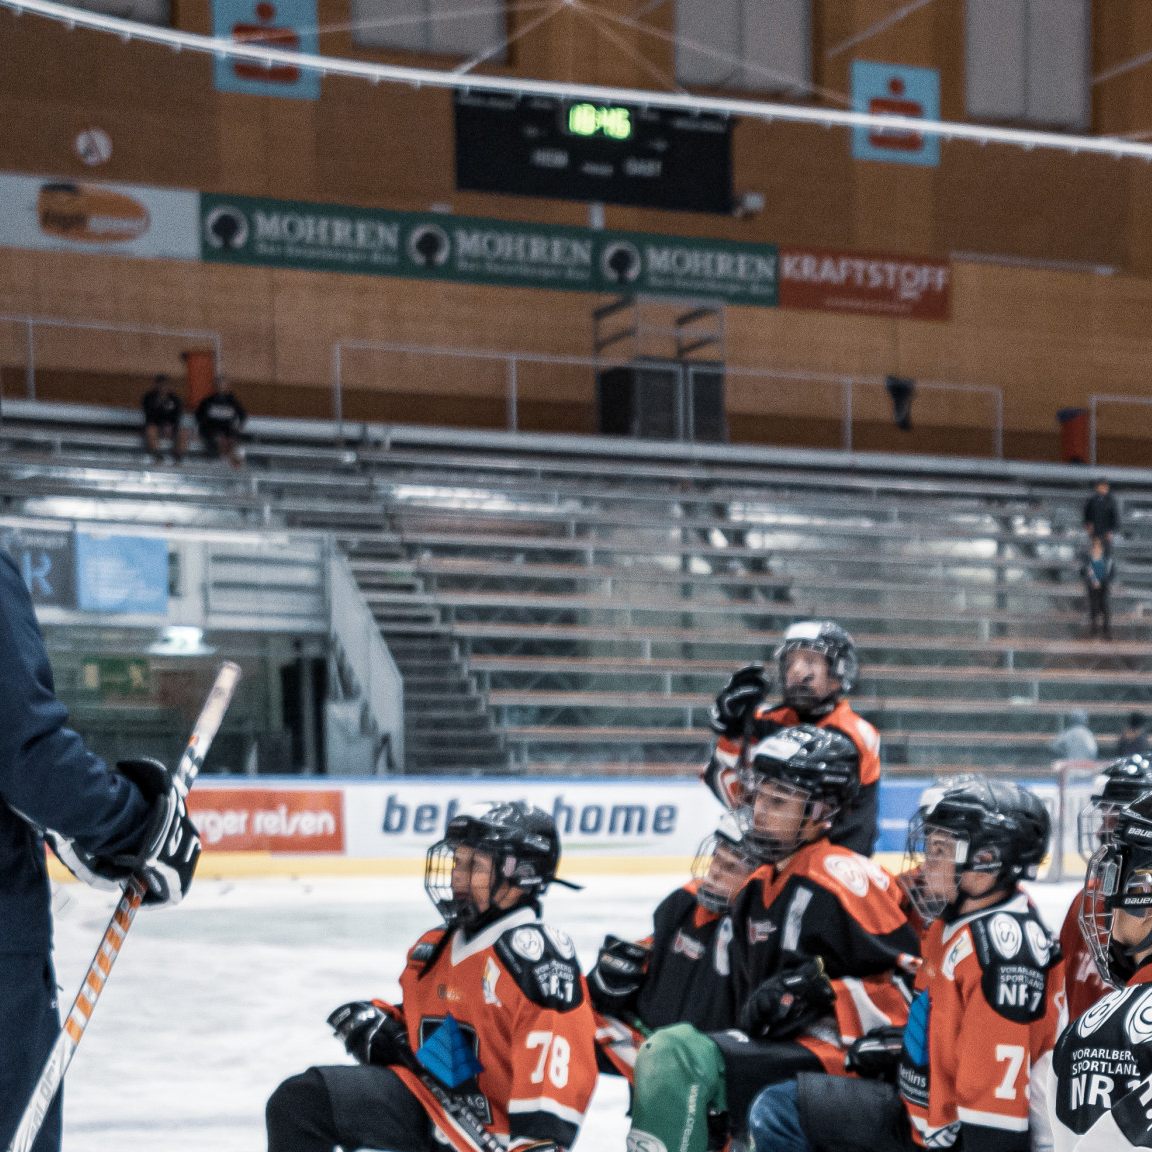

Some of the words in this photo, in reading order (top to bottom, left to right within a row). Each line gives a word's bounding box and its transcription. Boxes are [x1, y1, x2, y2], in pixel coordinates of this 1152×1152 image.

[255, 211, 399, 248] MOHREN
[455, 229, 592, 265] MOHREN
[646, 246, 775, 280] MOHREN
[783, 255, 948, 297] KRAFTSTOFF
[525, 1031, 570, 1088] 78
